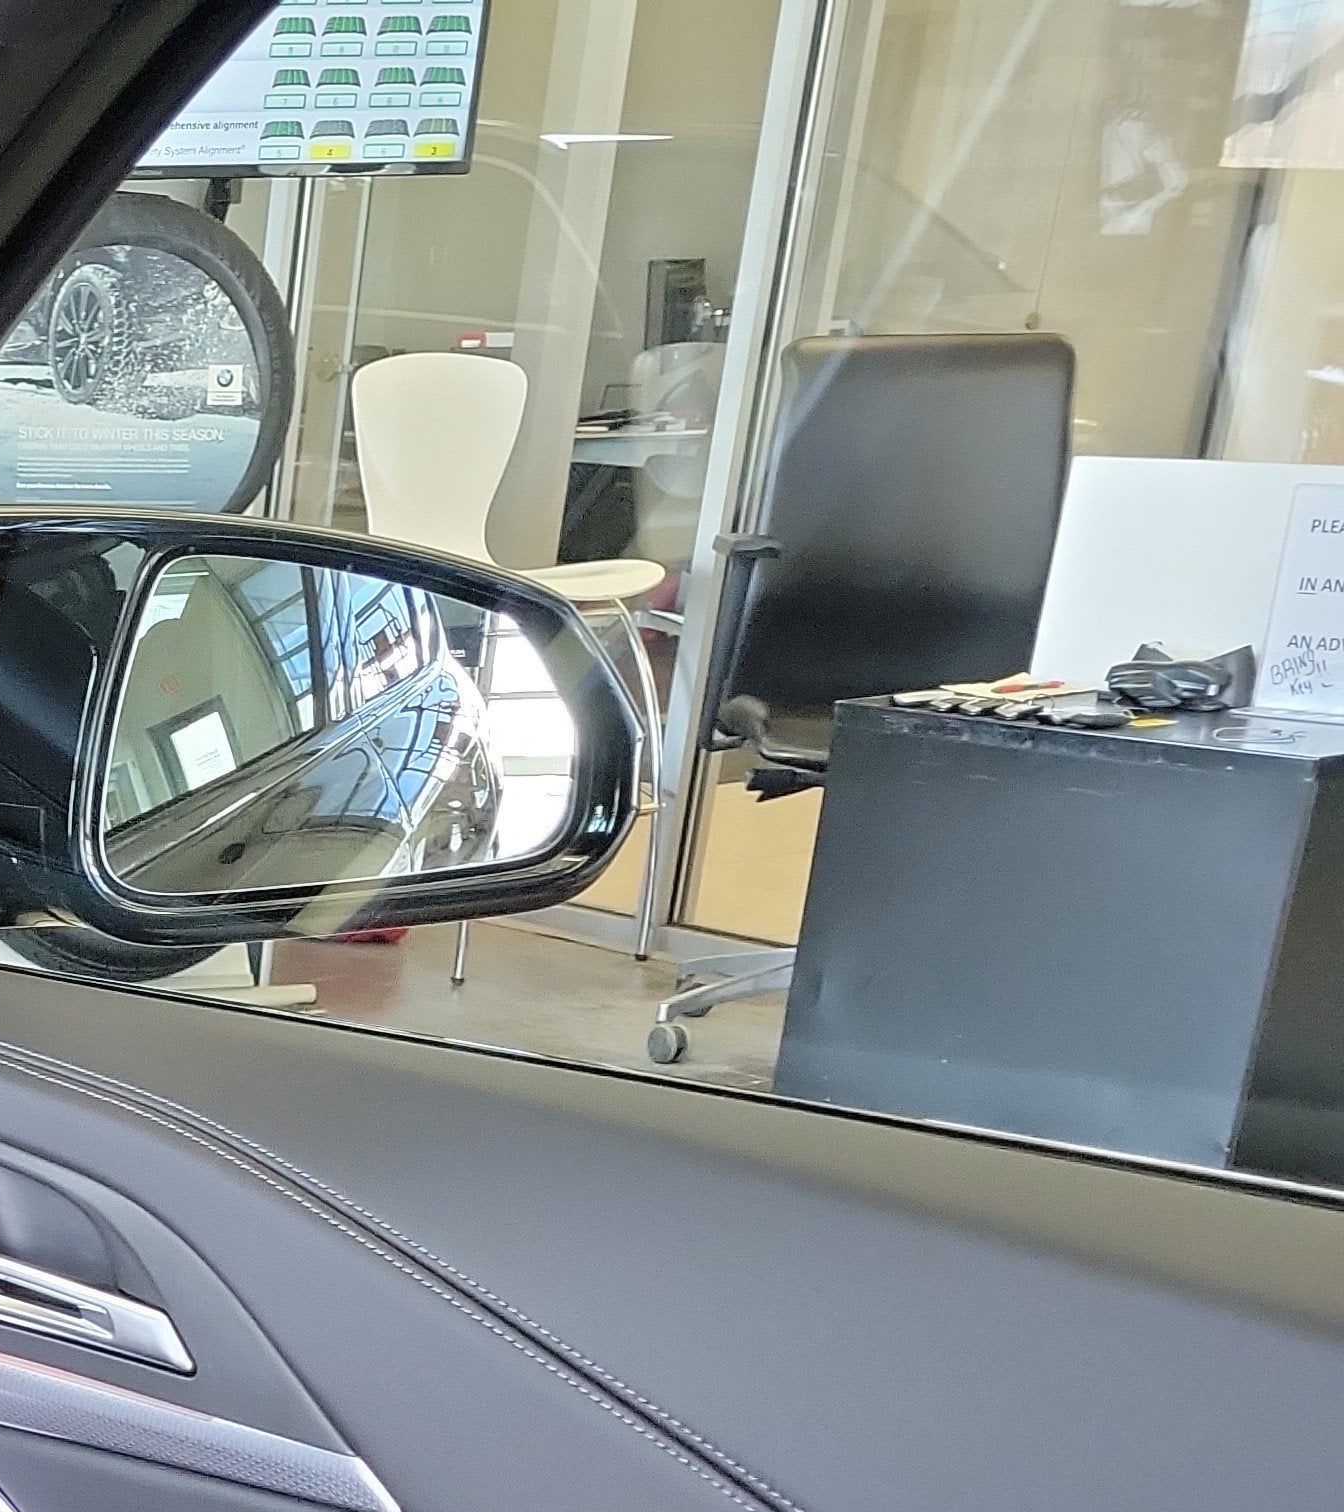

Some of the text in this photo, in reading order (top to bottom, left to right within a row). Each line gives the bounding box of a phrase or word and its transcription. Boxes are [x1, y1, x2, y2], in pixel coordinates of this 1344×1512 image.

[213, 120, 259, 132] alignment
[164, 147, 196, 158] System
[143, 428, 169, 441] THIS
[1298, 577, 1318, 592] IN
[1287, 635, 1344, 651] AN AD
